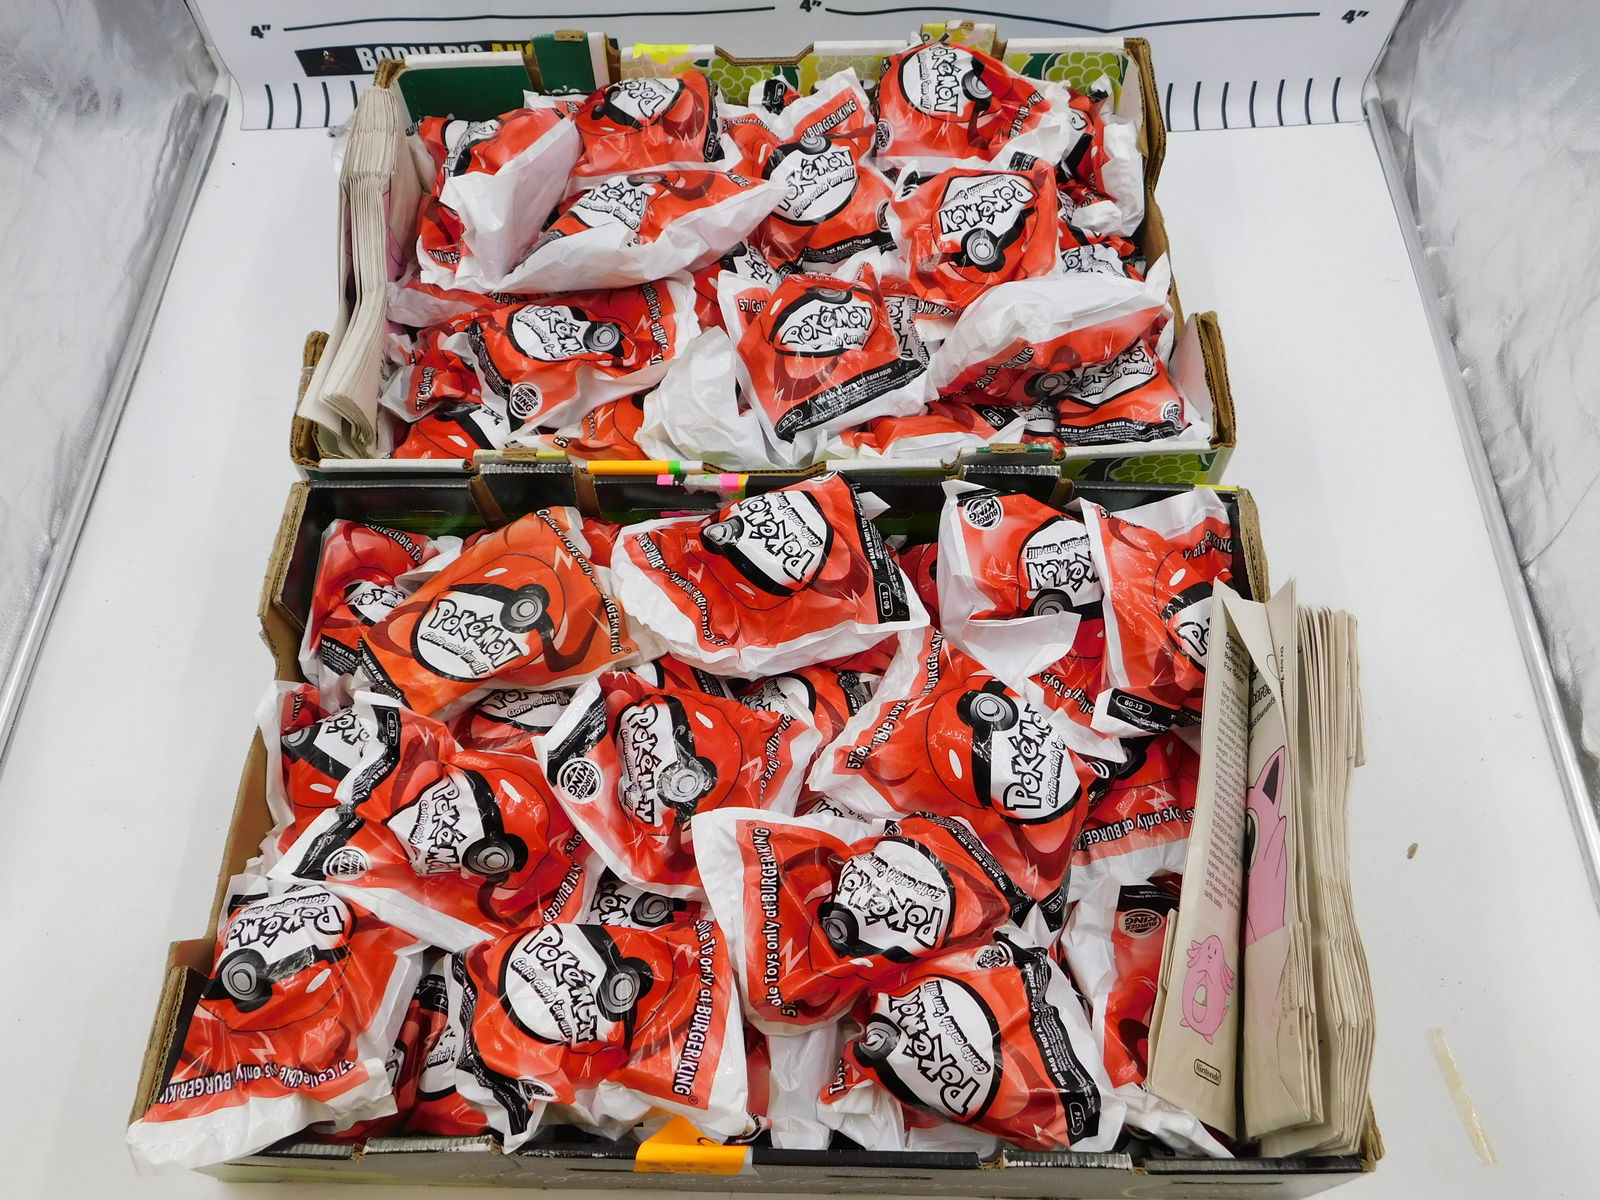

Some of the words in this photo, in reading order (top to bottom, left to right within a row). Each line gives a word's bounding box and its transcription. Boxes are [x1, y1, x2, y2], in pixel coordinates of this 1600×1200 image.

[250, 25, 271, 38] 4"
[1341, 10, 1369, 24] 4"
[511, 392, 535, 413] KING
[1123, 699, 1144, 712] 60-13
[1003, 703, 1054, 812] POKéMO
[567, 762, 590, 797] KING
[752, 827, 772, 857] KING
[759, 855, 780, 902] BURGER
[762, 919, 782, 951] only
[699, 957, 717, 988] only
[764, 952, 782, 985] Toys
[681, 1002, 714, 1062] BURGER
[178, 1070, 233, 1101] BURGER
[671, 1056, 700, 1097] KING
